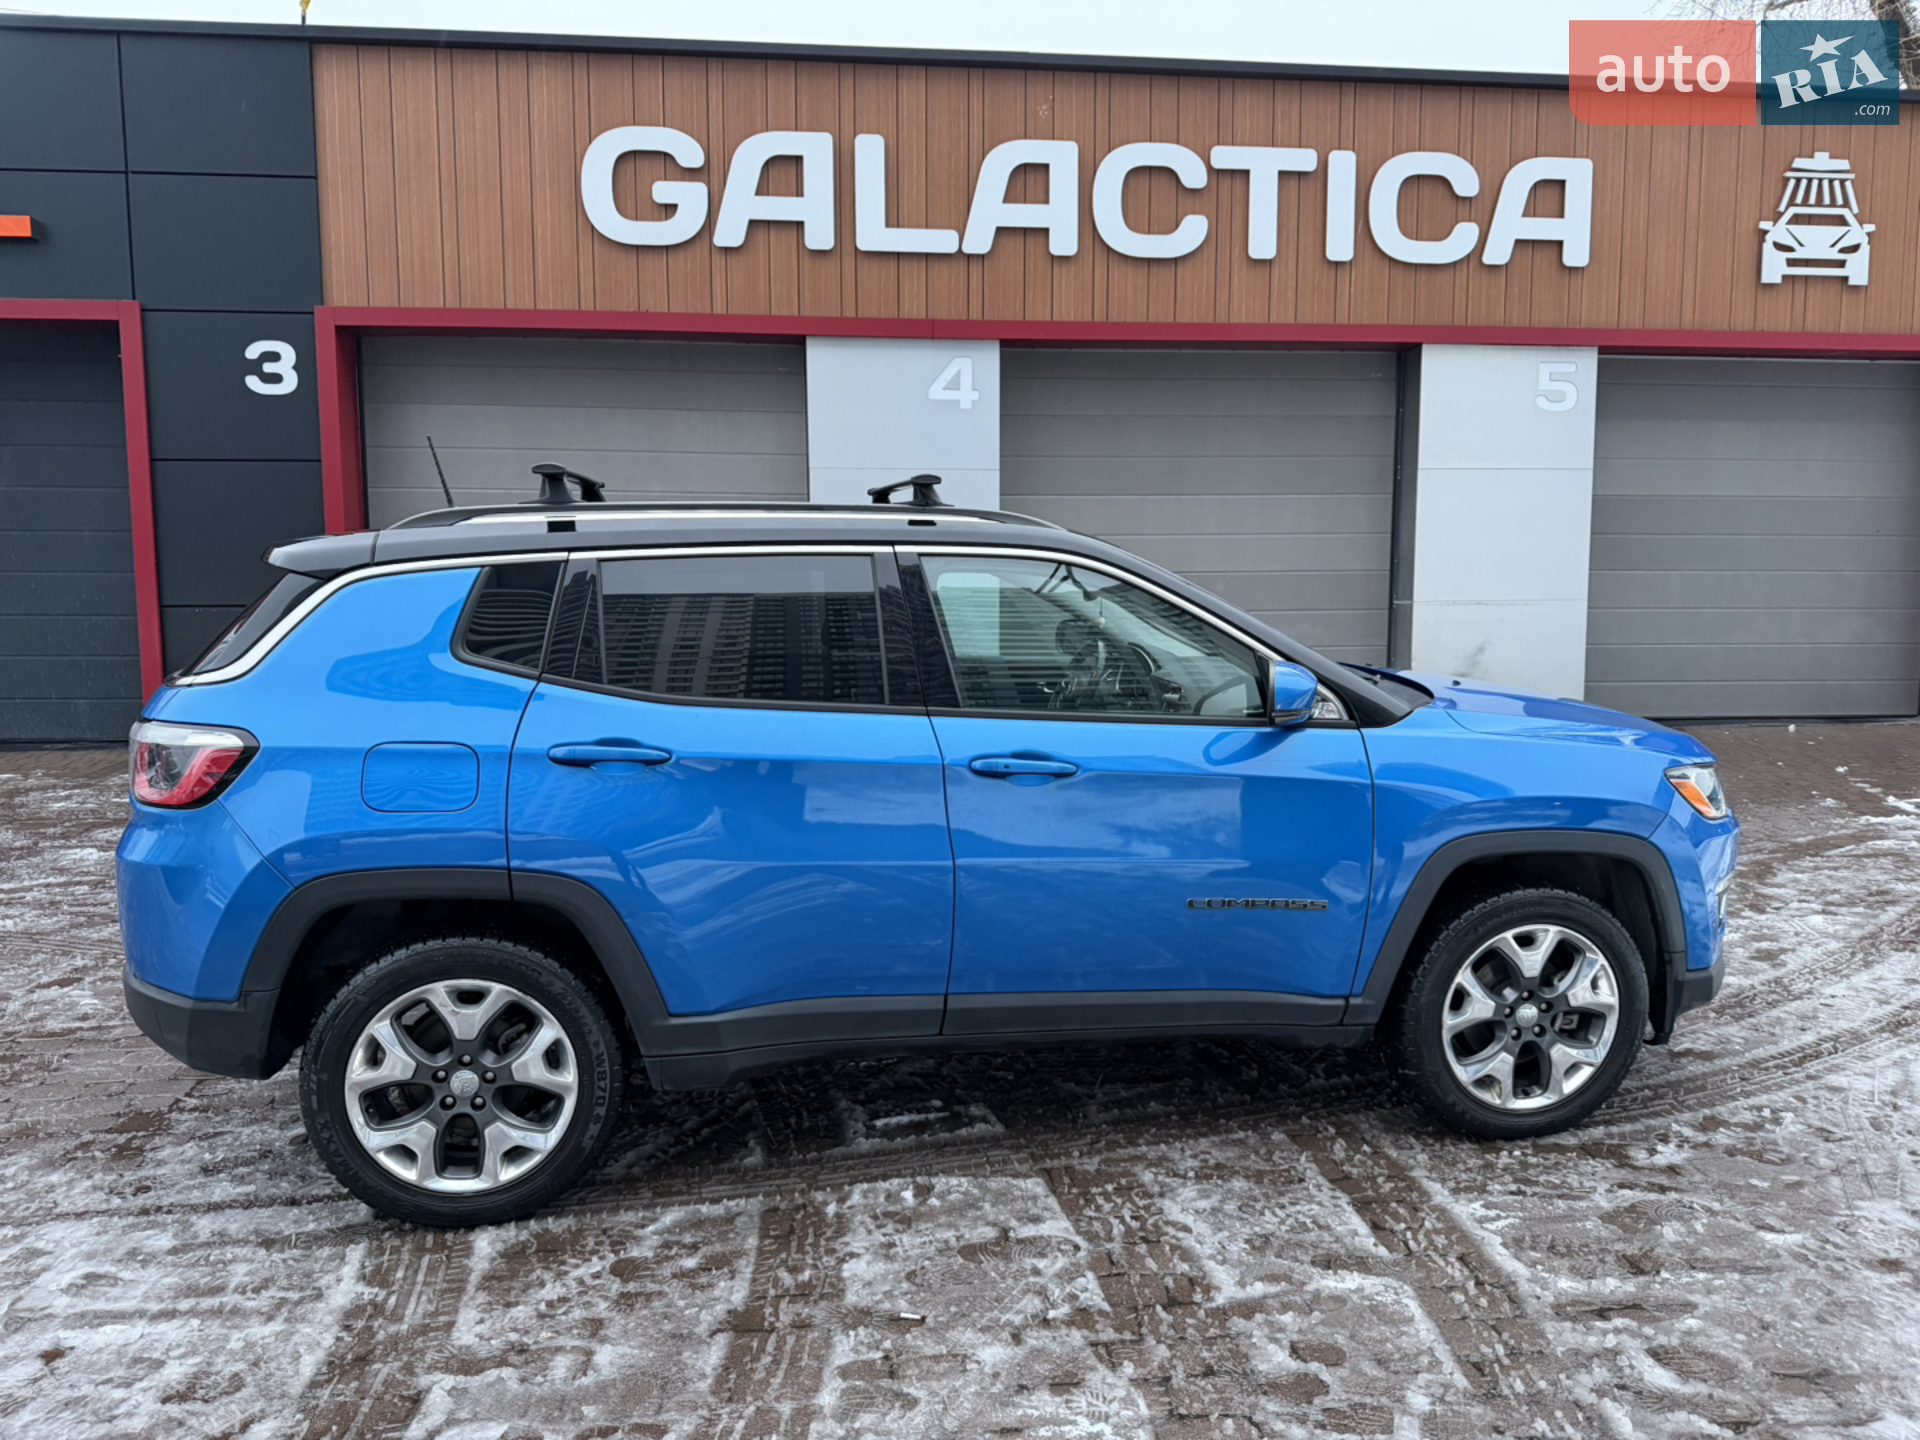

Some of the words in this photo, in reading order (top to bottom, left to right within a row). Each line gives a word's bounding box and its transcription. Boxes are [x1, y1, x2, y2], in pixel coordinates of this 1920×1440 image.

[581, 125, 1594, 267] GALACTICA
[244, 340, 298, 395] 3
[928, 356, 980, 409] 4
[1535, 361, 1579, 412] 5
[1187, 898, 1328, 909] COMPASS
